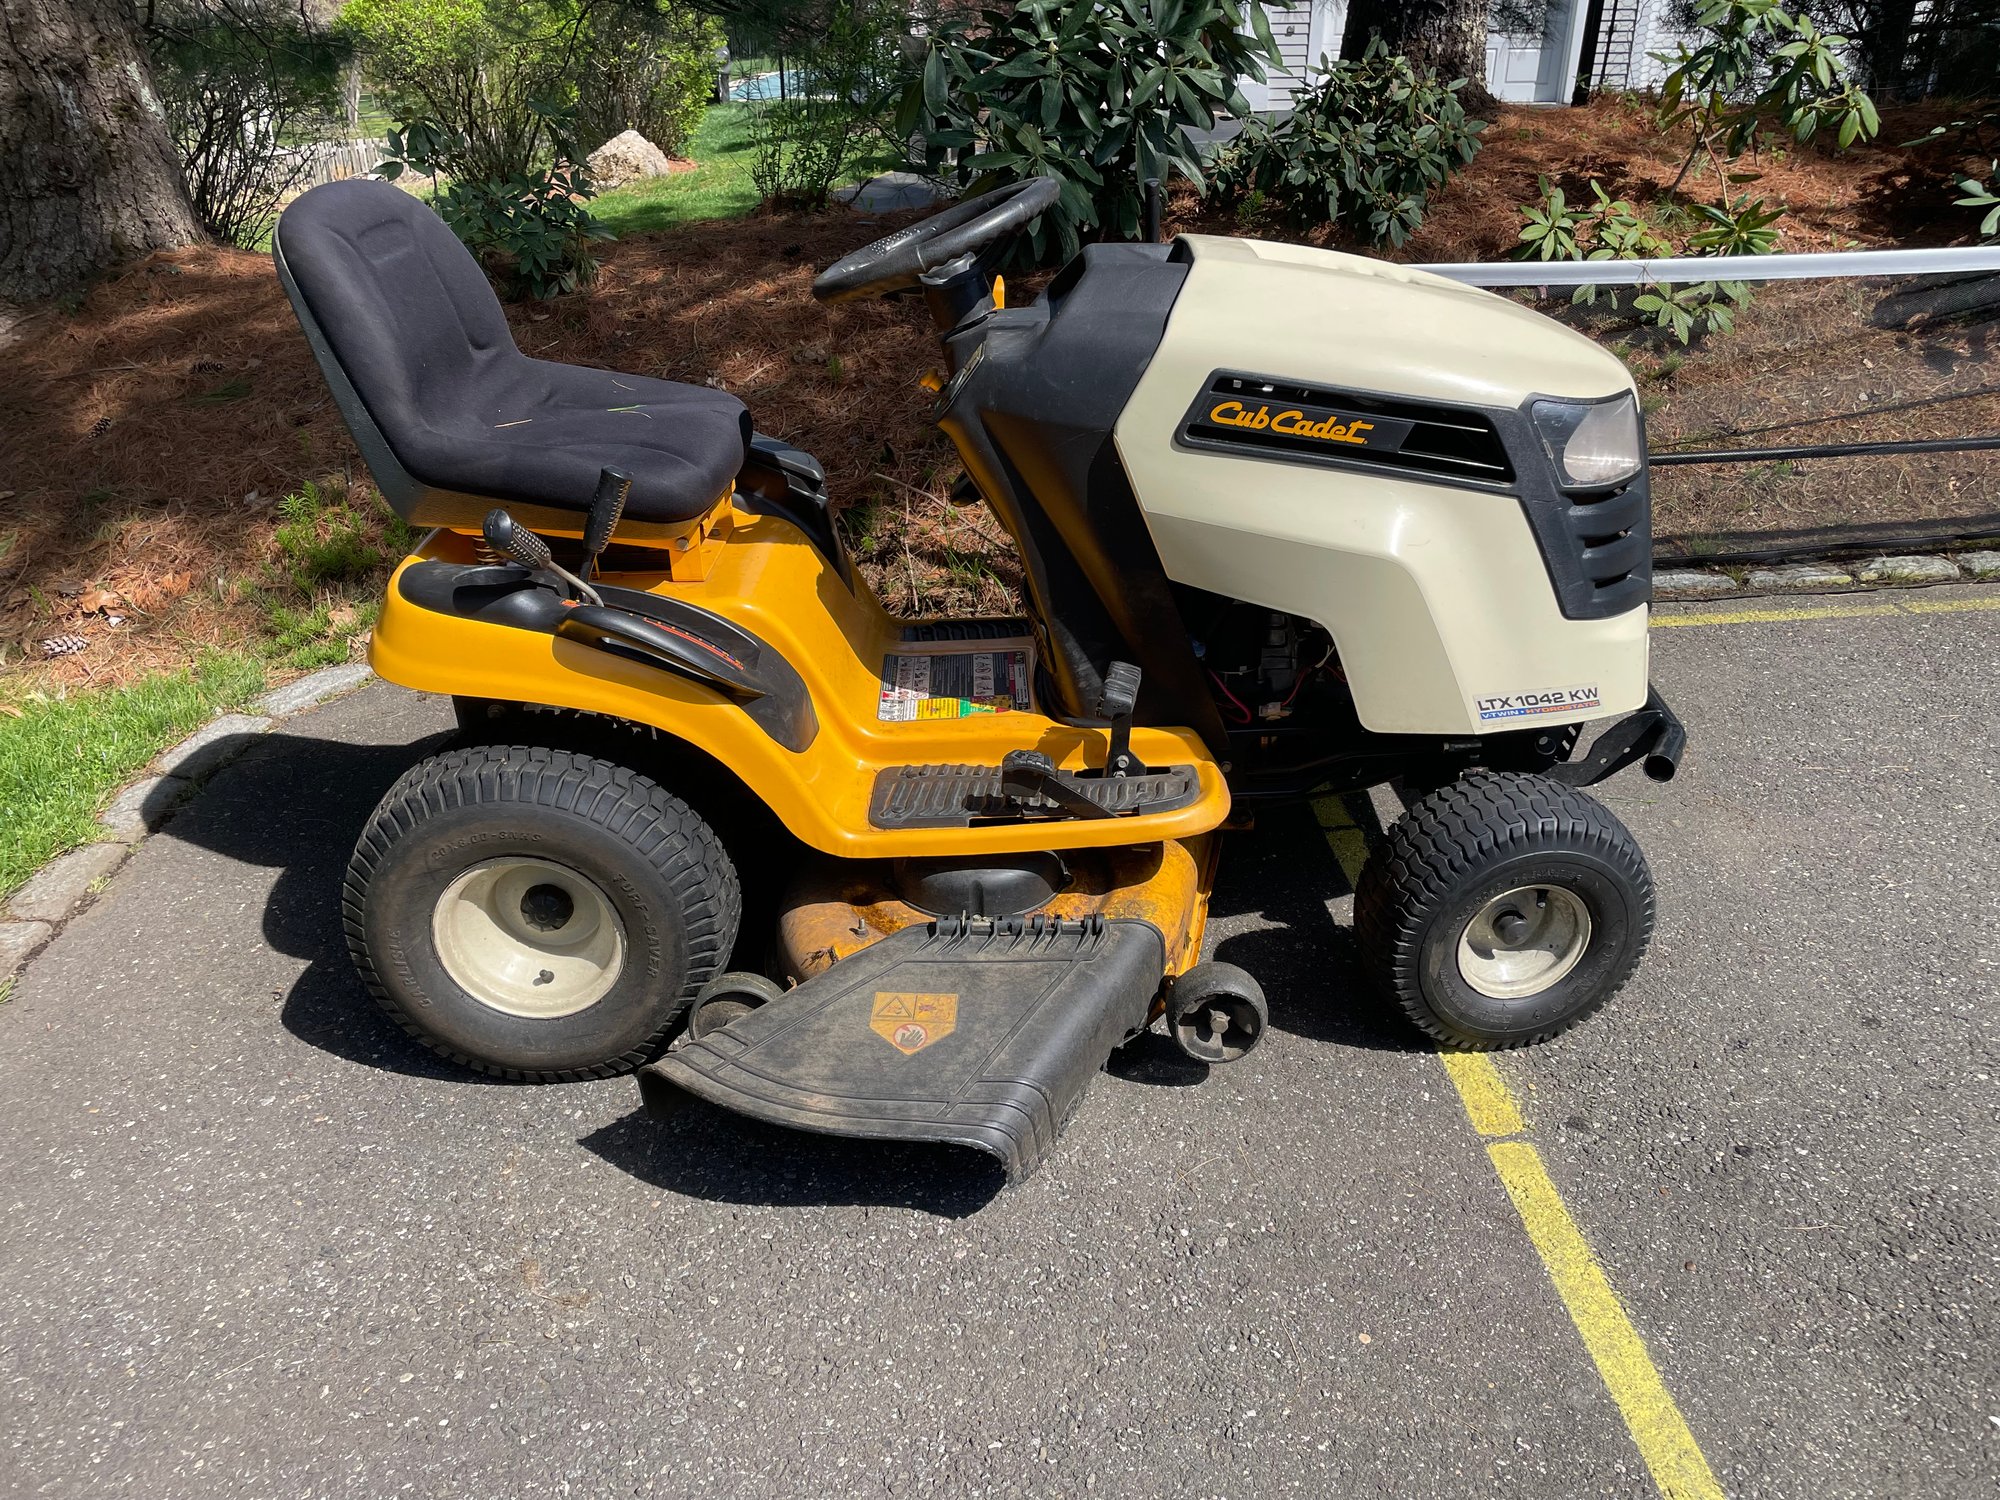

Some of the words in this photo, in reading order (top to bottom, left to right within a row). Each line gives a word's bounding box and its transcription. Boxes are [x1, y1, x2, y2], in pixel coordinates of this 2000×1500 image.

[1210, 401, 1270, 430] Cub
[1270, 410, 1374, 444] Cadet
[1477, 696, 1514, 711] LTX
[1515, 692, 1566, 707] 1042
[1569, 687, 1598, 701] KW
[1525, 701, 1599, 714] HYDROSTATIC
